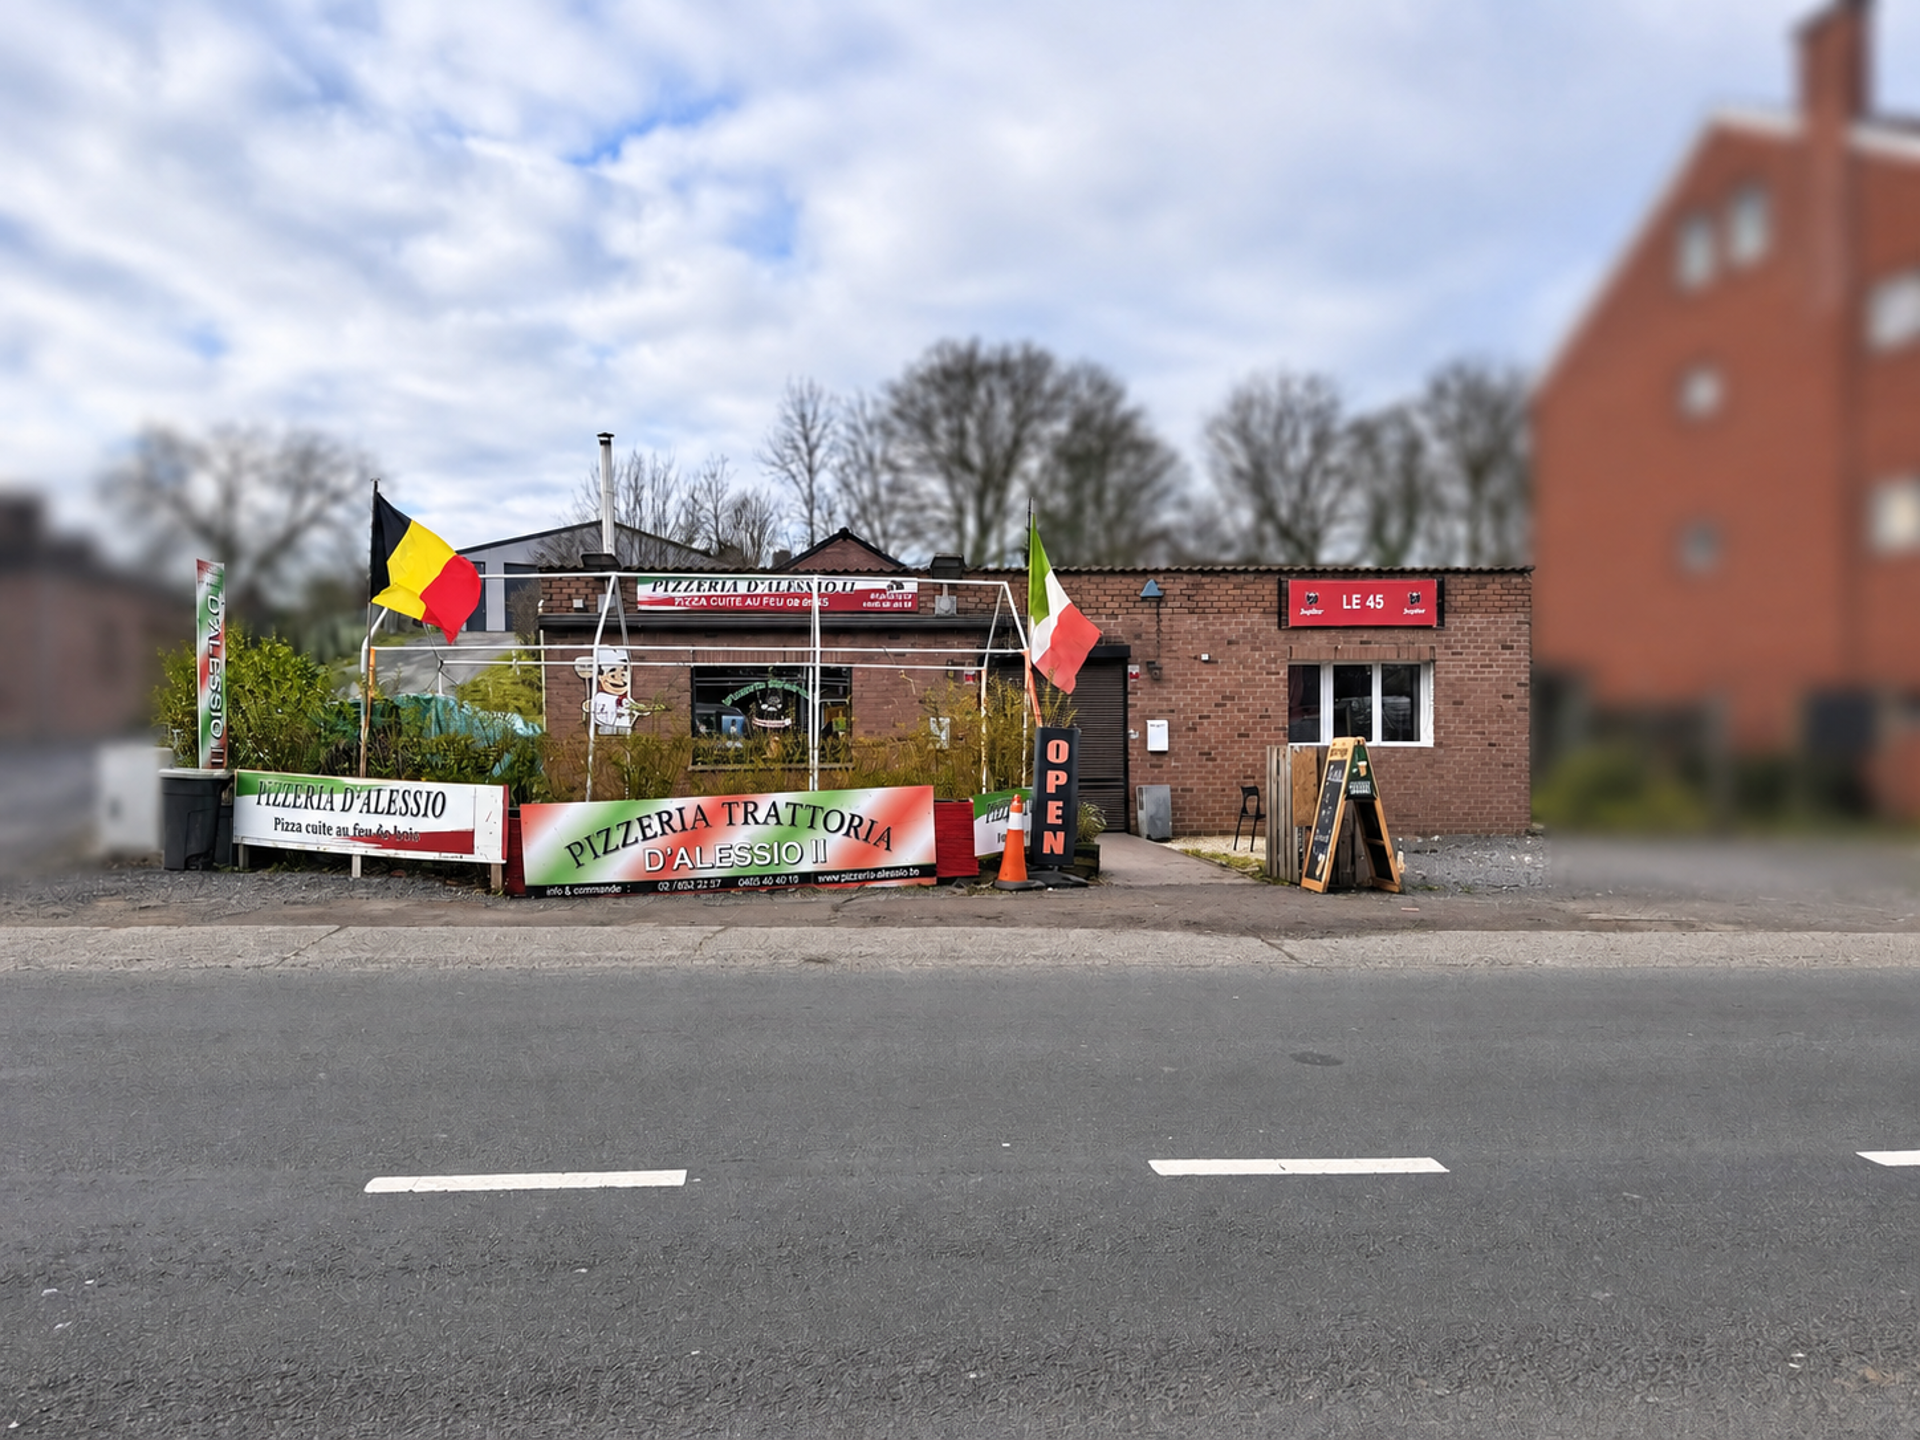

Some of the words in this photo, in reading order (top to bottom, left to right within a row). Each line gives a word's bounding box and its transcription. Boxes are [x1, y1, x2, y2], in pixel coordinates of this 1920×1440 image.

[651, 580, 738, 594] PIZZERIA
[710, 596, 742, 606] CUITE
[745, 597, 760, 606] AU
[762, 597, 784, 606] FEU
[1342, 594, 1361, 609] LE
[1366, 594, 1384, 609] 45
[256, 780, 335, 812] PIZZERIA
[340, 786, 446, 819] D'ALESSIO
[1042, 739, 1070, 855] OPEN
[274, 817, 302, 833] Pizza
[305, 819, 333, 836] cuite
[336, 825, 350, 837] au
[352, 822, 373, 838] feu
[564, 804, 713, 869] PIZZERIA
[721, 800, 893, 852] TRATTORIA
[643, 841, 804, 872] D'ALESSIO
[546, 886, 563, 896] info
[564, 886, 571, 895] &
[573, 885, 622, 895] commande
